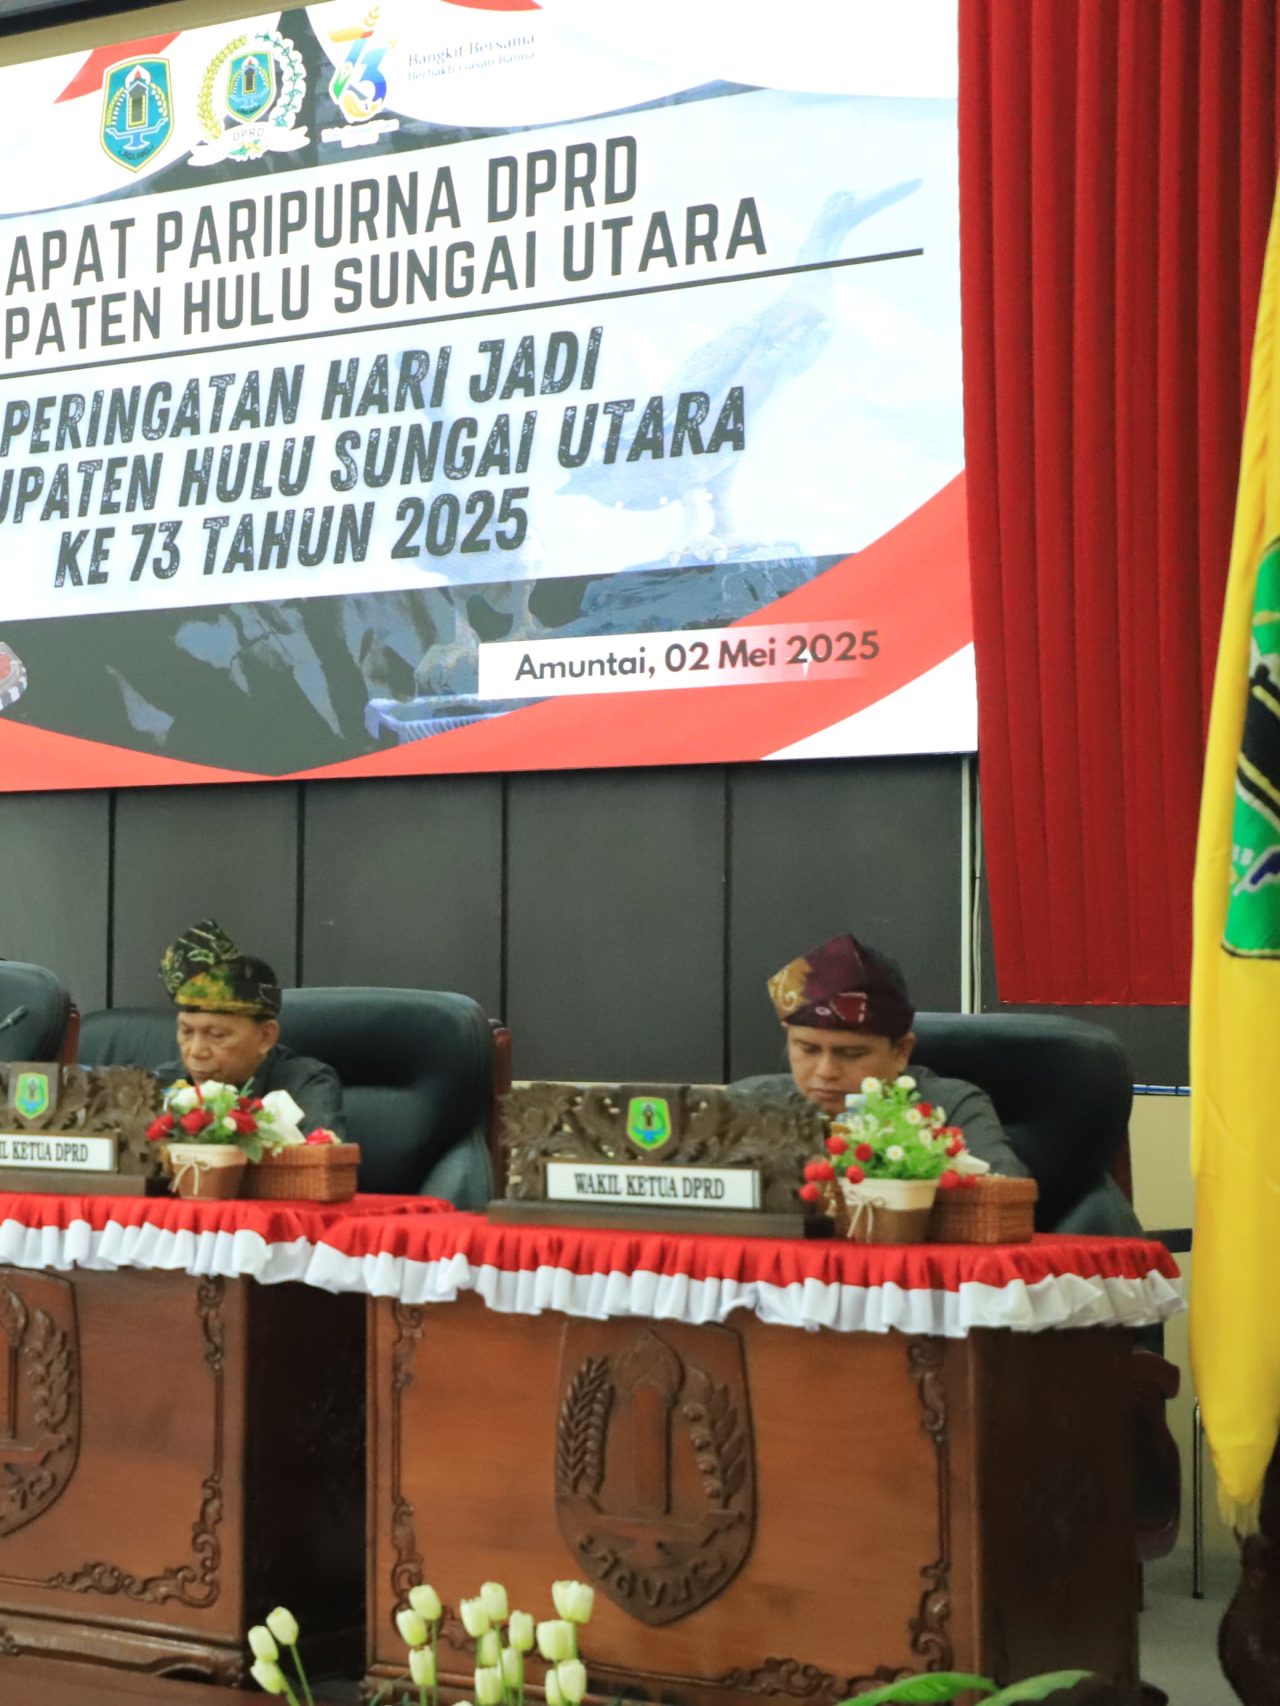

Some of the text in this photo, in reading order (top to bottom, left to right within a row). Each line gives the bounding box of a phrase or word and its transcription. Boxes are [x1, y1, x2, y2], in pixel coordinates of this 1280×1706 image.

[232, 127, 265, 141] DPRD
[156, 166, 461, 273] PARIPURNA
[487, 135, 637, 222] DPRD
[184, 265, 309, 335] HULU
[334, 231, 536, 314] SUNGAI
[563, 197, 767, 282] UTARA
[0, 327, 602, 457] PERINGATAN HARI JADI
[178, 435, 315, 507] HULU
[330, 411, 537, 494] SUNGAI
[557, 386, 745, 469] UTARA
[55, 486, 529, 587] KE 73 TAHUN 2025
[515, 630, 880, 681] Amuntai, 02 Mei 2025
[12, 1141, 54, 1161] KETUA
[55, 1143, 89, 1163] DPRD
[574, 1172, 725, 1200] WAKIL KETUA DPRD
